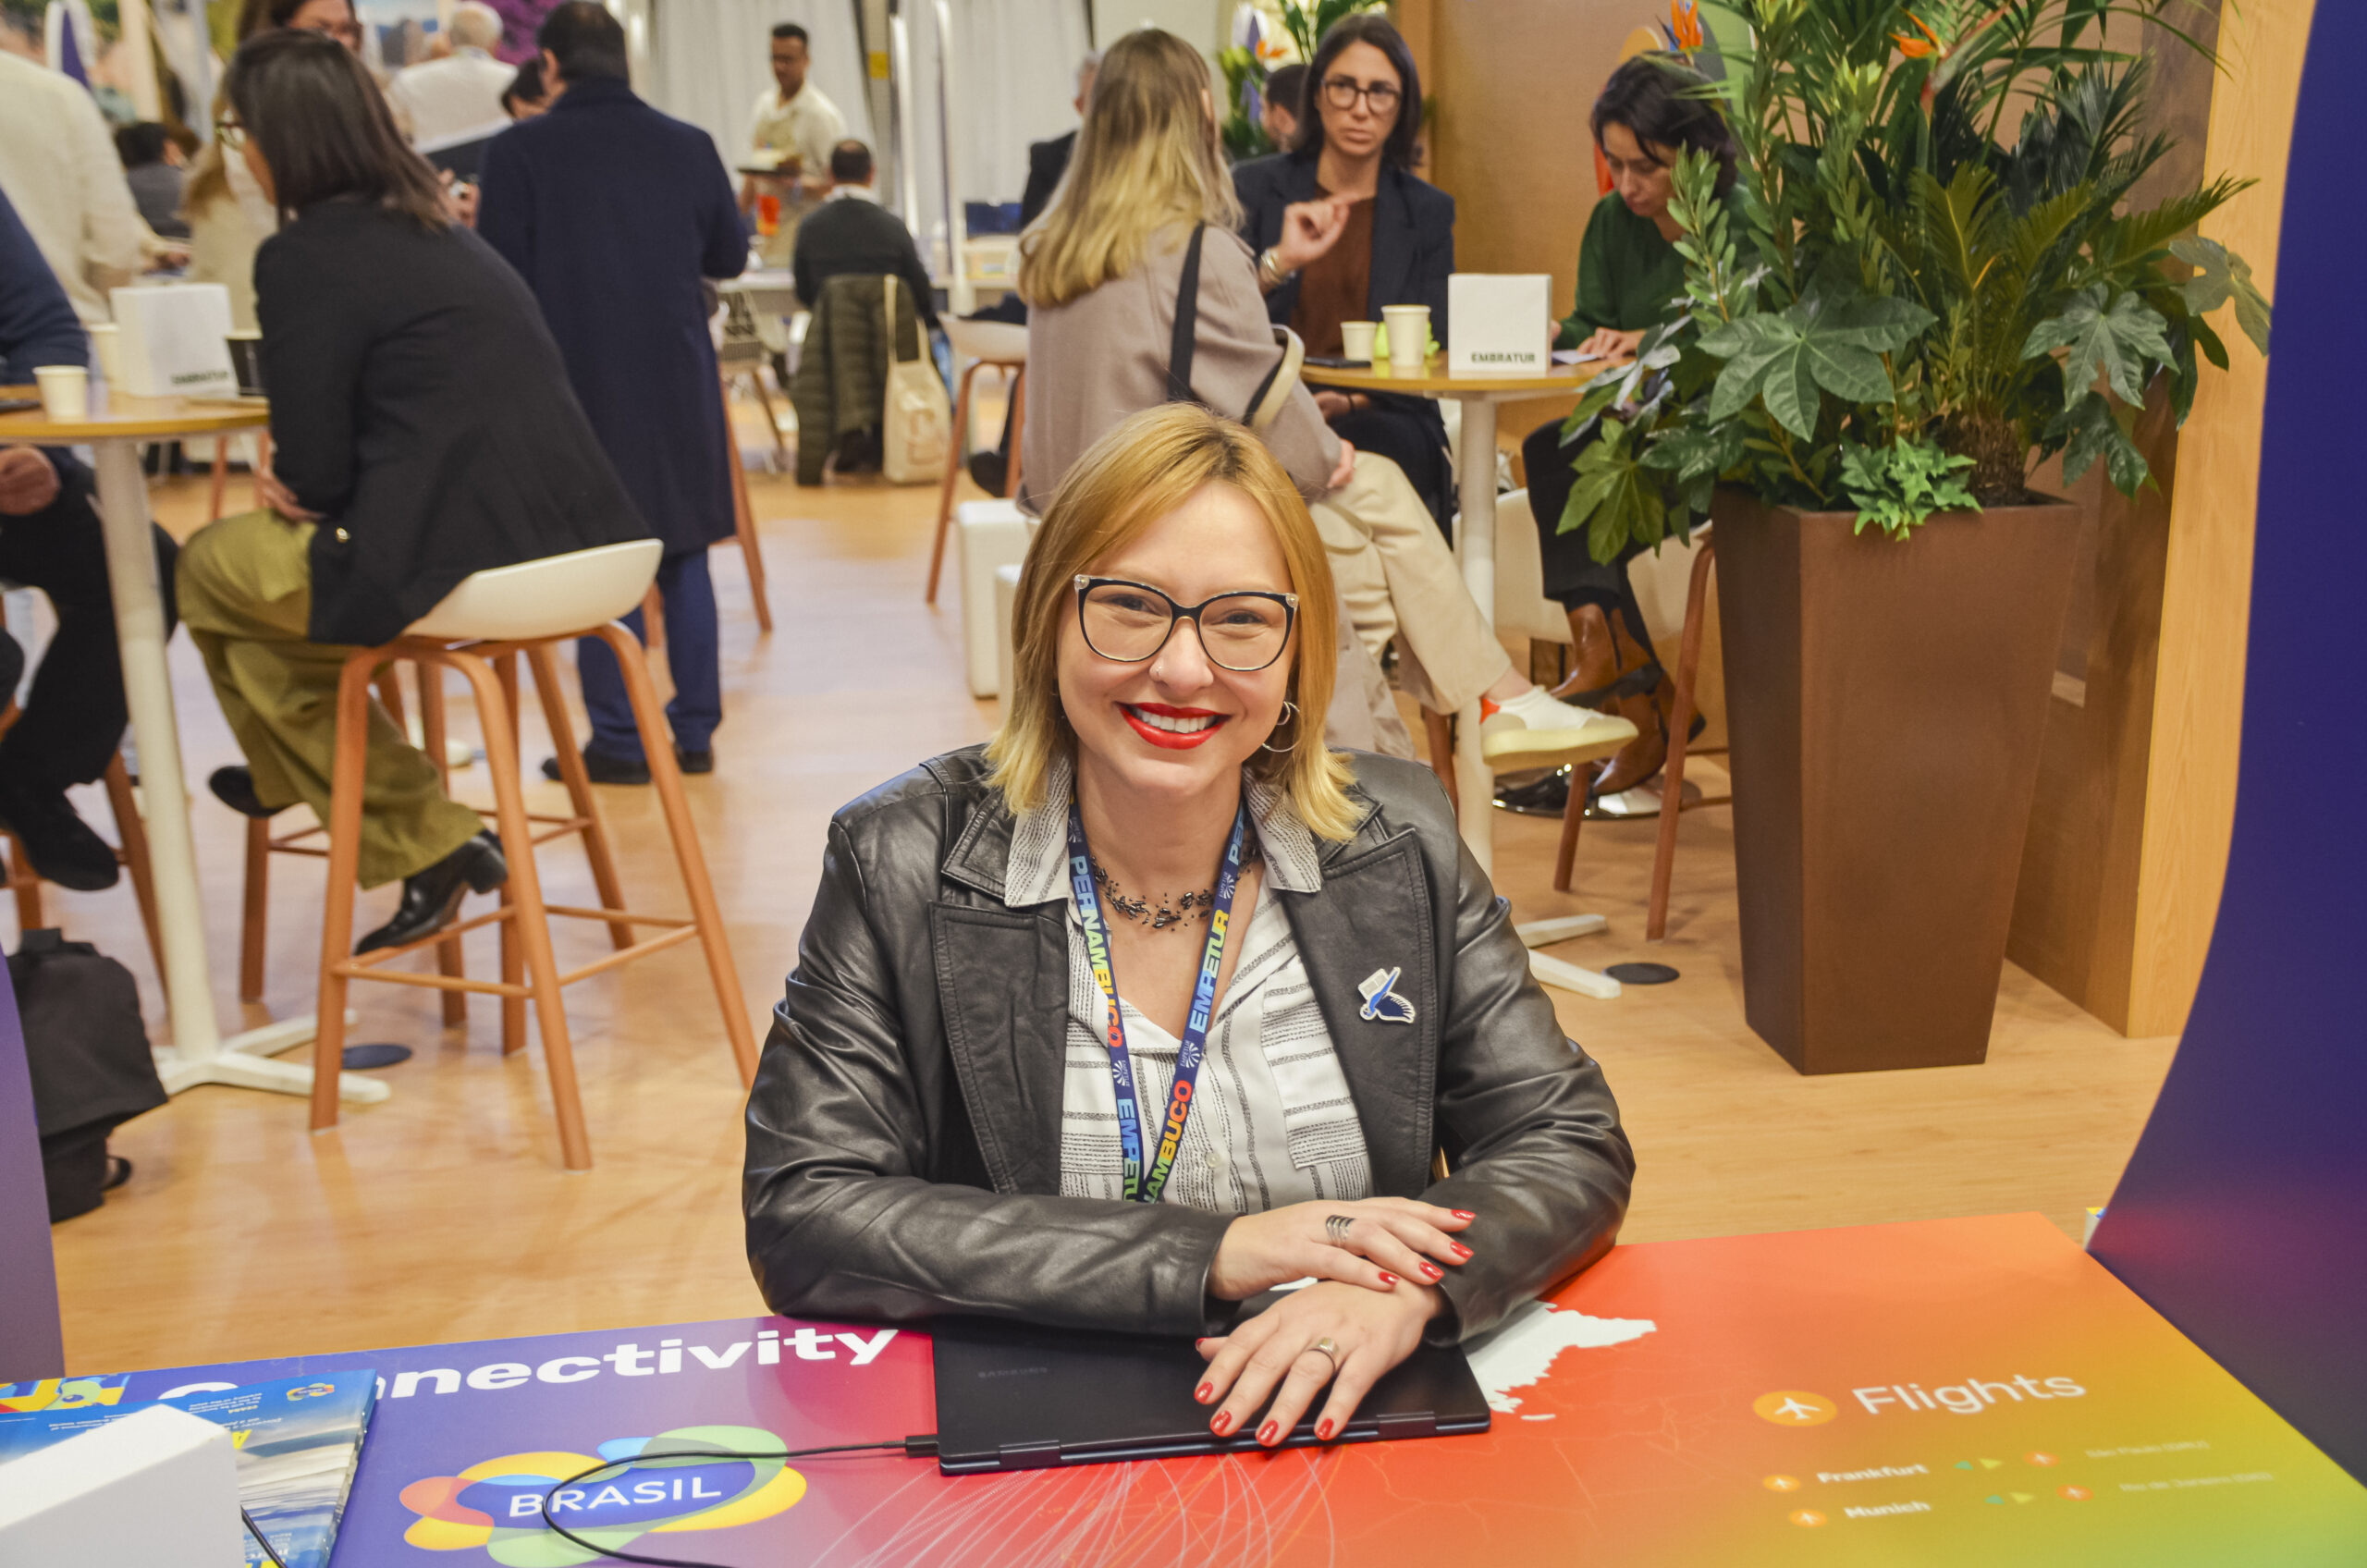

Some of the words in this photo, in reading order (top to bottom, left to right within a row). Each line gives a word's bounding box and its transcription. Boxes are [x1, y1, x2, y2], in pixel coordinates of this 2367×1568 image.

[1471, 353, 1536, 363] EMBRATUR
[1189, 909, 1230, 1034] EMPETUR
[1117, 1098, 1140, 1202] EMPETU
[1144, 1080, 1193, 1204] AMBUCO
[159, 1328, 899, 1400] nectivity
[1852, 1374, 2086, 1415] Flights
[1817, 1464, 1929, 1483] Frankfurt
[509, 1477, 721, 1517] BRASIL
[1844, 1501, 1932, 1518] Munich
